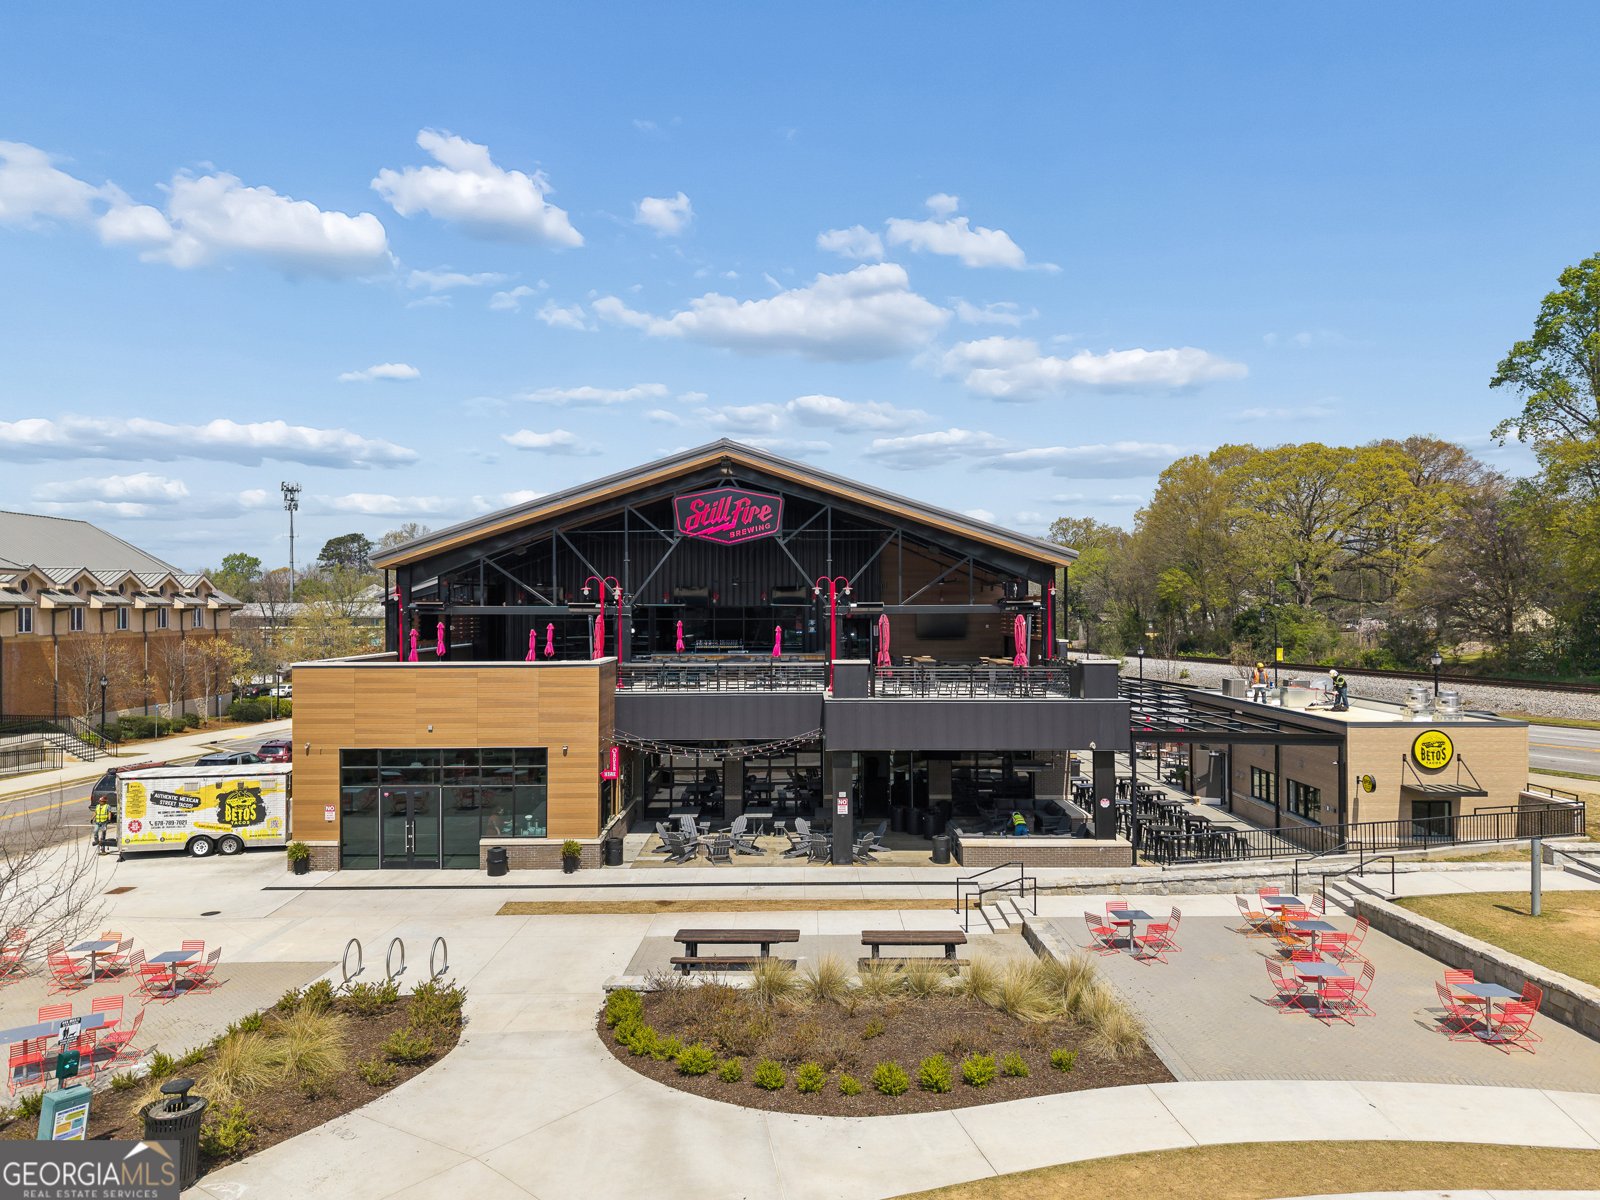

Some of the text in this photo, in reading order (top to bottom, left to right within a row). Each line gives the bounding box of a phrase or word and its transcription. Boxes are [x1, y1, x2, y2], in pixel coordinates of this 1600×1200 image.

[729, 523, 771, 538] BREWING
[1421, 747, 1446, 760] BETO'S
[226, 804, 257, 821] BETO'S
